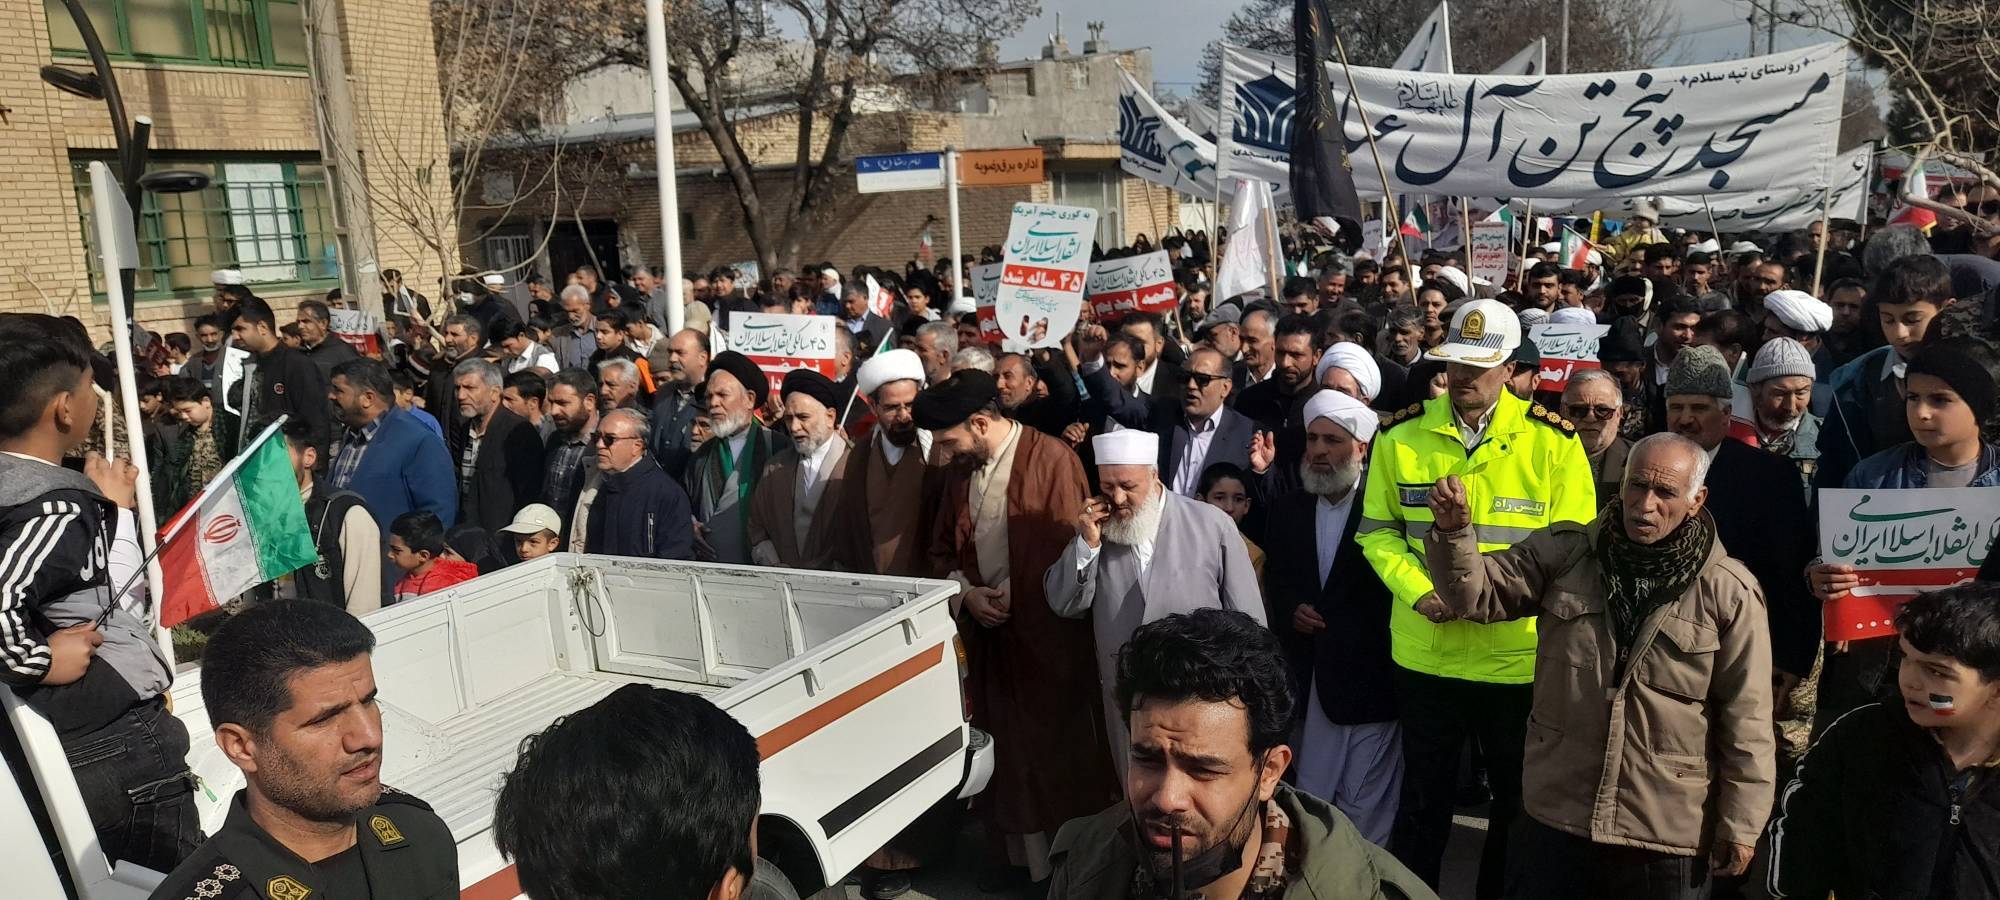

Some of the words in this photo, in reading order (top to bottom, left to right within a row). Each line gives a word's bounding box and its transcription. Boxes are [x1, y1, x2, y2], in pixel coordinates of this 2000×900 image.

[1688, 71, 1725, 89] سلام
[1727, 66, 1748, 84] تپه
[1750, 63, 1801, 81] روستای
[1394, 77, 1544, 187] آل
[1506, 77, 1617, 189] تن
[1592, 71, 1684, 190] پنج
[1662, 71, 1831, 191] مسجد
[999, 158, 1016, 173] برق
[1017, 157, 1039, 173] اداره
[1012, 205, 1038, 217] آمریکا
[1039, 208, 1057, 218] چشم
[1058, 210, 1082, 220] کوری
[1082, 212, 1090, 220] به
[1010, 237, 1039, 262] ایران
[1029, 237, 1081, 263] انقلاب
[1003, 269, 1024, 285] شد
[1026, 270, 1056, 287] ساله
[1059, 272, 1081, 291] ۴۵
[1092, 274, 1111, 291] ایران
[1106, 268, 1138, 290] انقلاب
[1141, 286, 1175, 305] همه
[734, 330, 758, 352] ایران
[751, 328, 793, 353] انقلاب
[785, 319, 812, 356] سالگی
[809, 336, 827, 351] ۴۵
[1543, 336, 1588, 357] انقلاب
[1494, 498, 1512, 512] راه
[1514, 502, 1543, 515] پلیس
[1831, 523, 1887, 566] ایران
[1874, 515, 1980, 564] انقلاب
